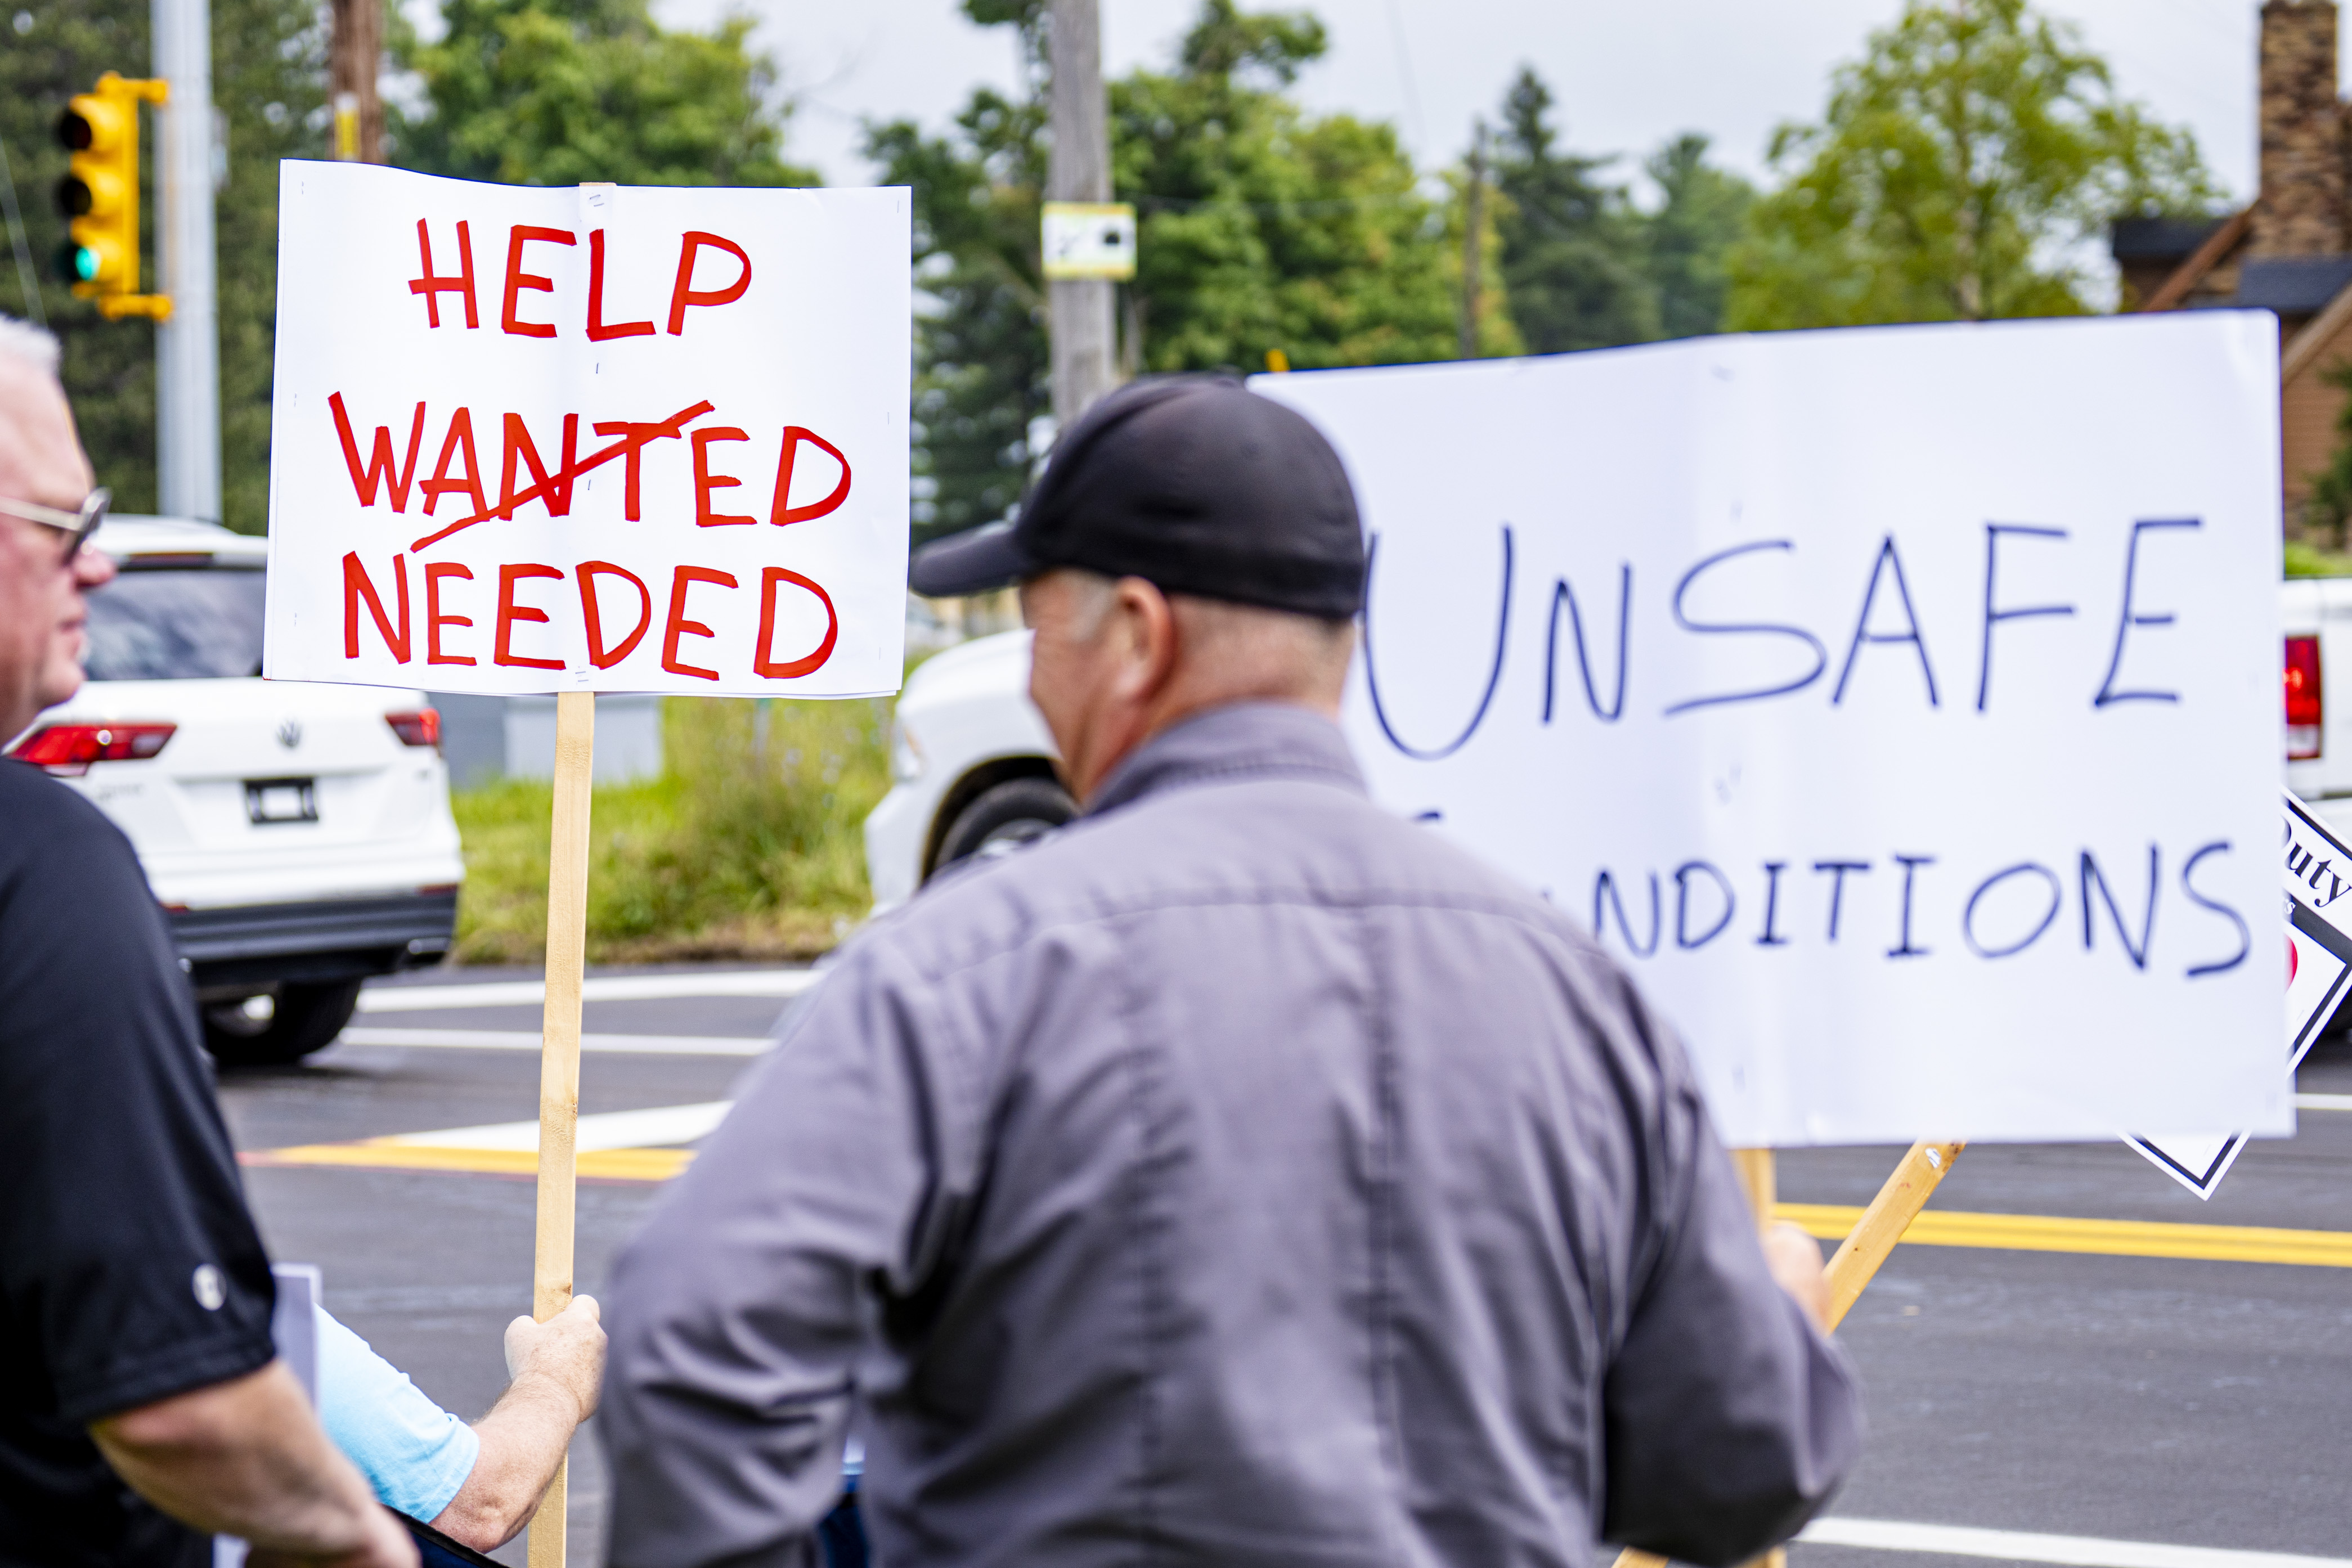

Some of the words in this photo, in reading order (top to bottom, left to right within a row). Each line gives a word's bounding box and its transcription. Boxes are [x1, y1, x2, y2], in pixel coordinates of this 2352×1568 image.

[409, 218, 752, 342] HELP
[328, 391, 851, 528] WANTED
[343, 550, 838, 681] NEEDED
[1362, 515, 2205, 761] UNSAFE
[1415, 809, 2252, 979] NDITIONS
